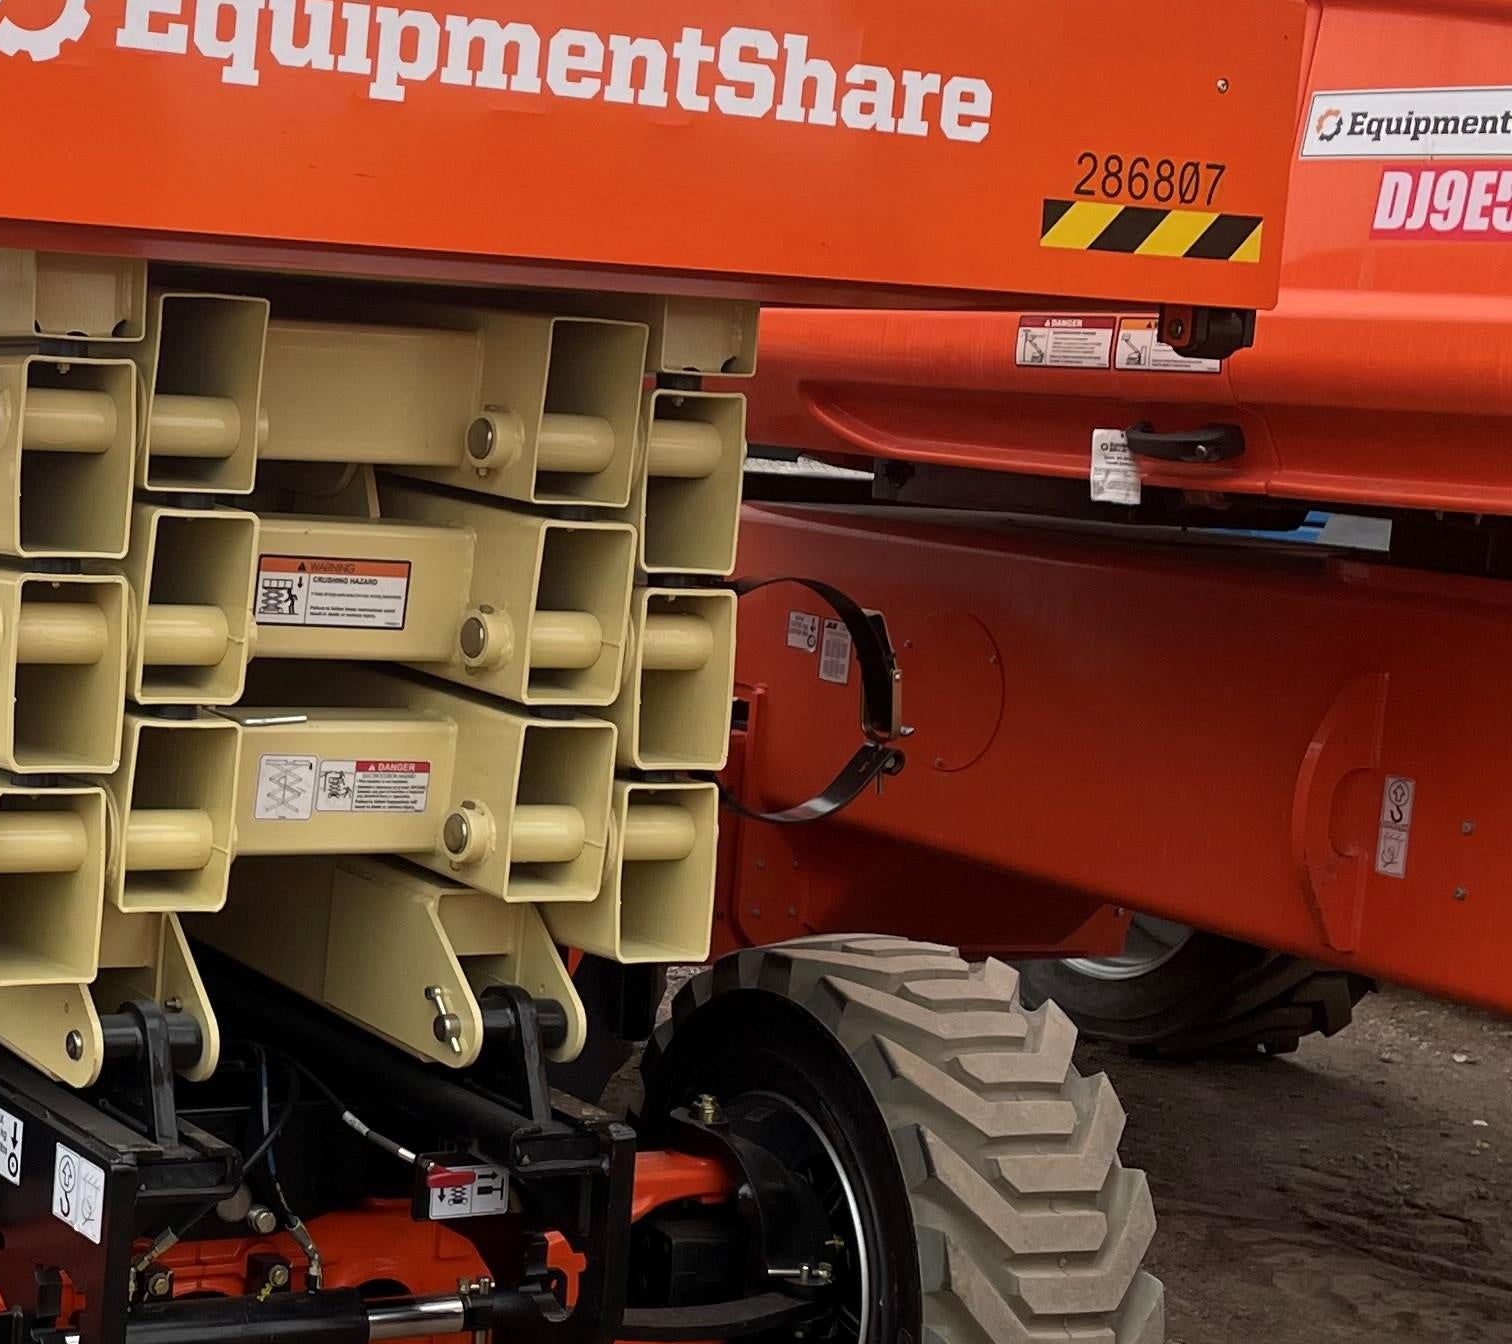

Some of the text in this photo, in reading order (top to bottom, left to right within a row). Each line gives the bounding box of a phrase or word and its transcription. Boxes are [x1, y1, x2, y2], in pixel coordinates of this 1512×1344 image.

[1073, 151, 1227, 206] 286807
[1051, 319, 1083, 327] DANGER
[310, 561, 356, 574] WARNING
[313, 576, 378, 586] CRUSHING HAZARD
[377, 762, 416, 772] DANGER
